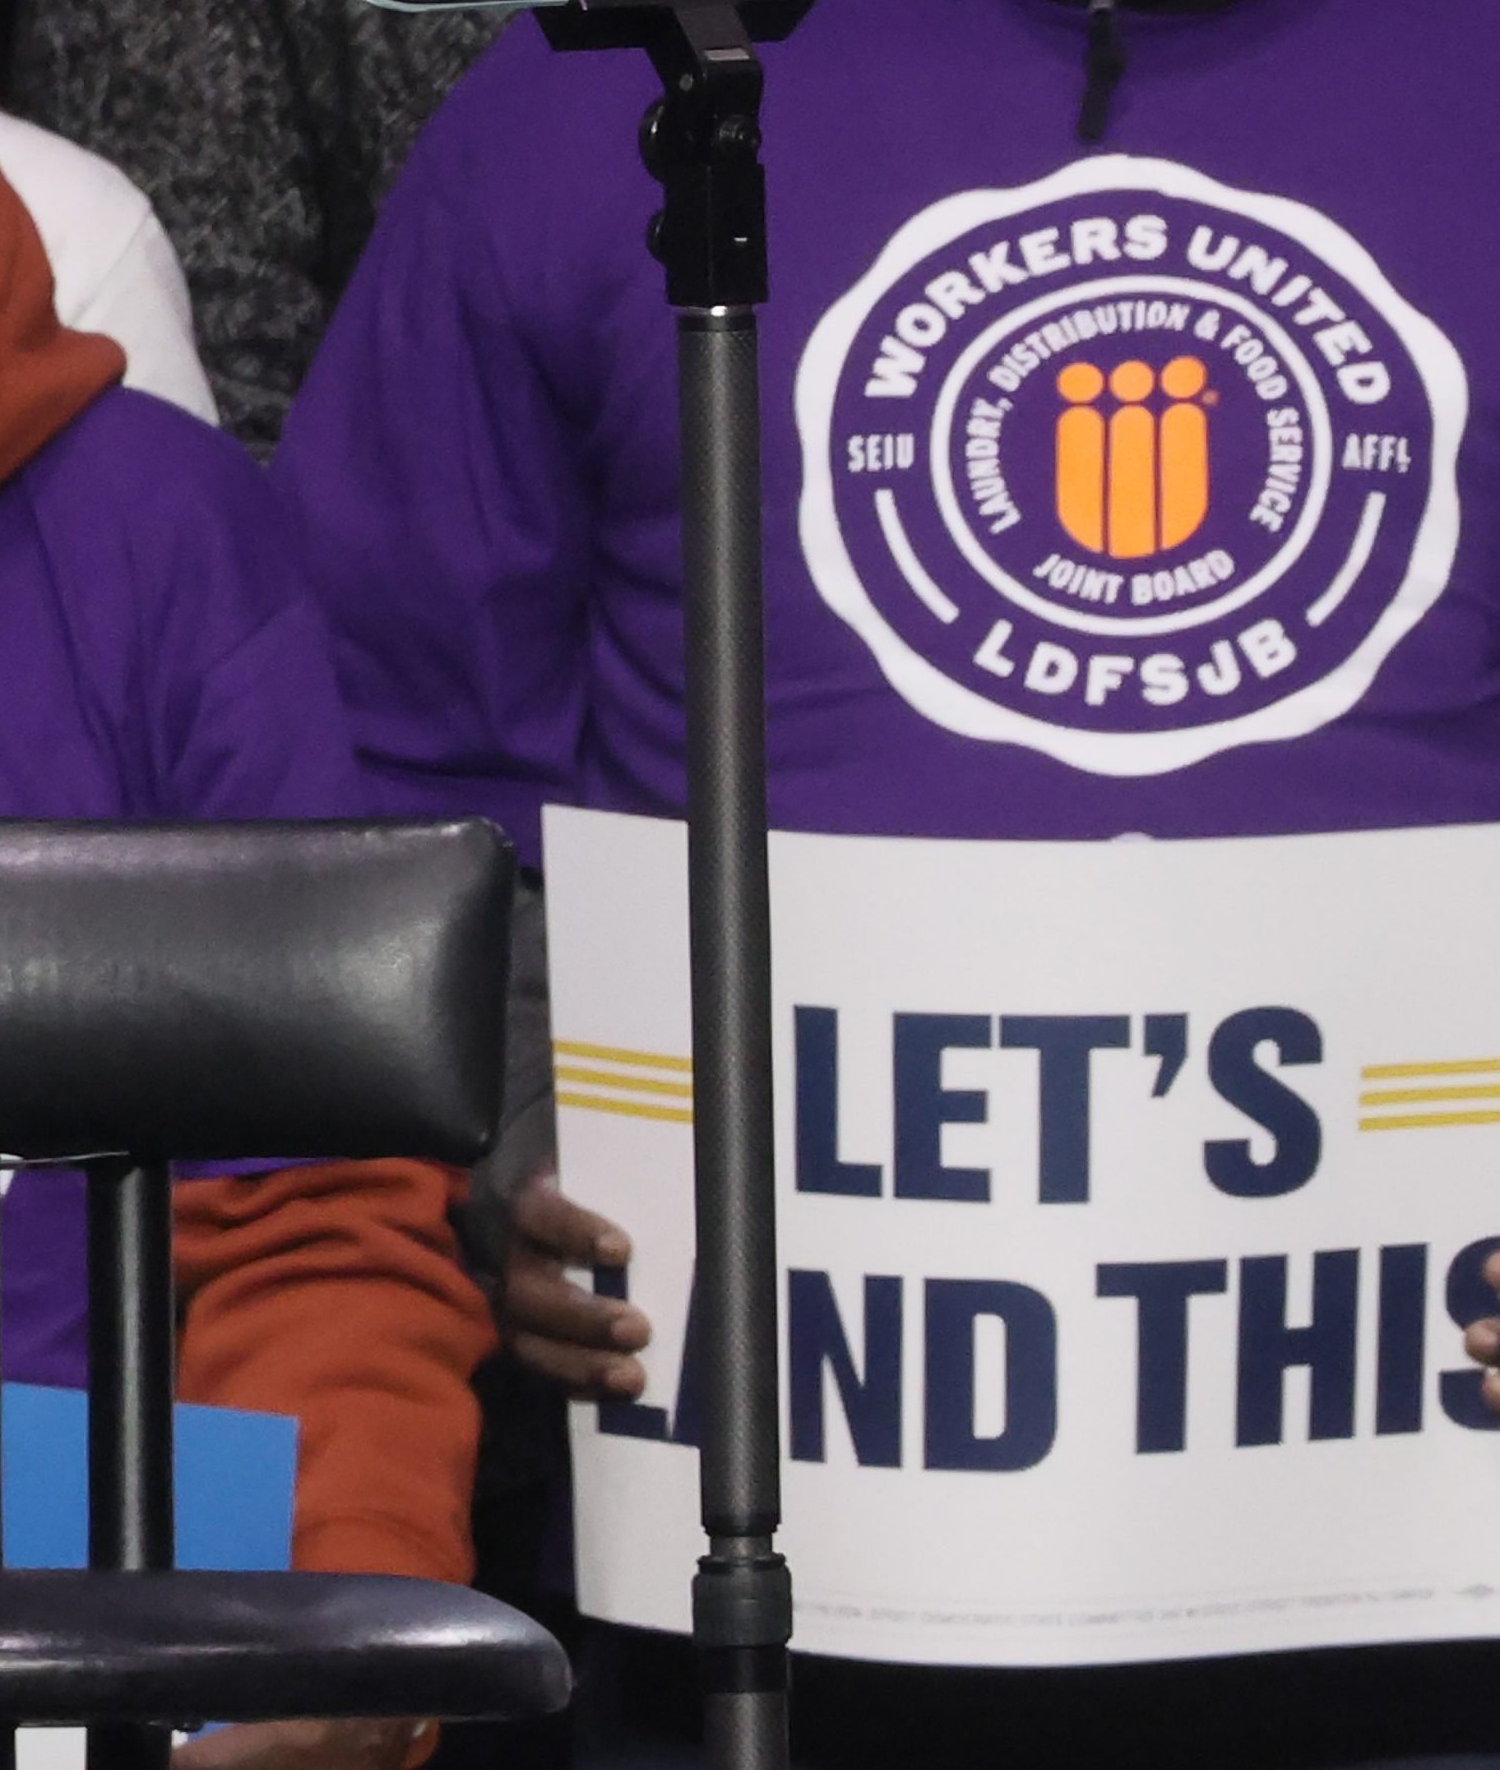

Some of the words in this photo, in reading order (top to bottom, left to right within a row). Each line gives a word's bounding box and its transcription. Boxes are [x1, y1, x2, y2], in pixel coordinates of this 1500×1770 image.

[866, 214, 1167, 397] WORKERS
[1188, 226, 1391, 404] UNITED
[989, 301, 1190, 393] DISTRIBUTION
[1194, 309, 1220, 340] &
[1221, 325, 1288, 400] FOOD
[848, 433, 914, 472] SEIU
[966, 399, 1021, 534] LAUNDRY,
[1250, 408, 1303, 533] SERVICE
[1033, 554, 1124, 603] JOINT
[1131, 550, 1234, 605] BOARD
[974, 619, 1296, 705] LDFSJB
[794, 1005, 1323, 1204] LET'S
